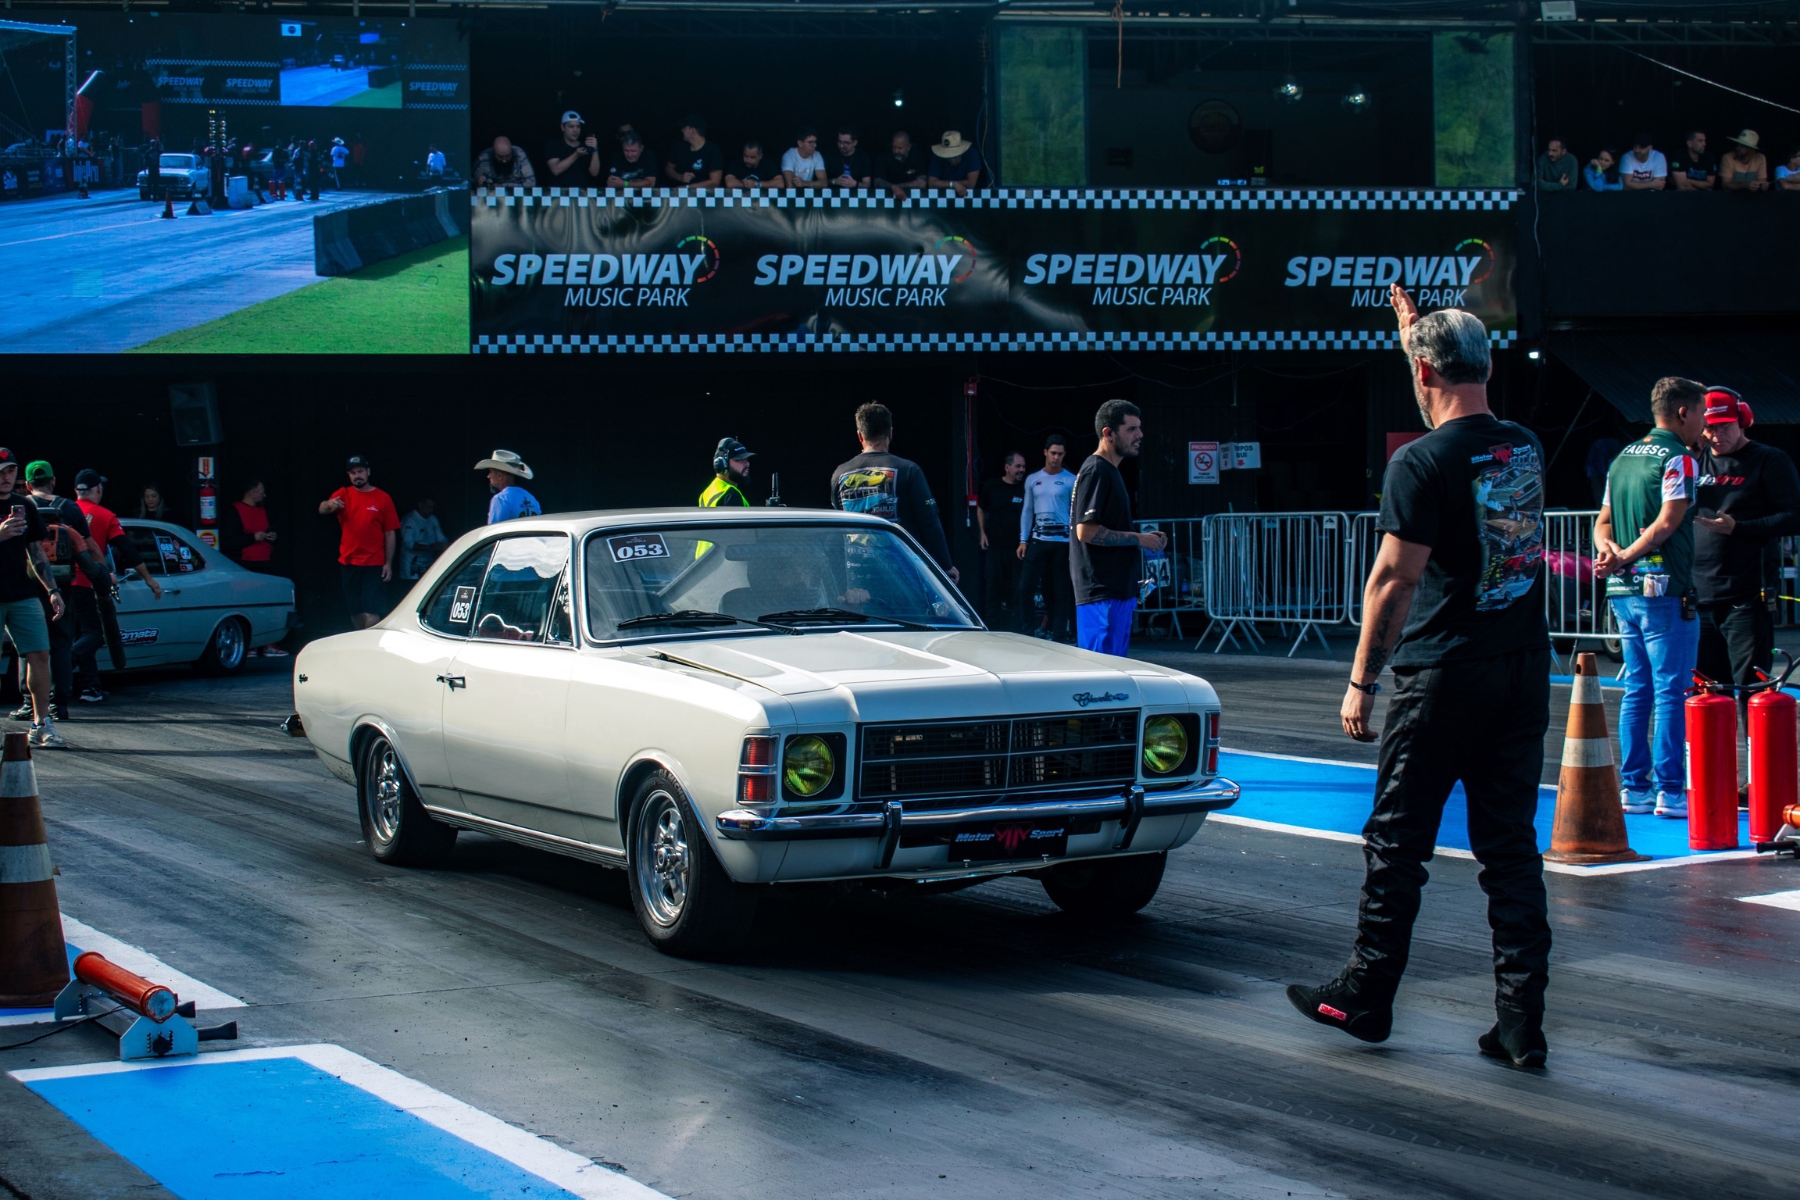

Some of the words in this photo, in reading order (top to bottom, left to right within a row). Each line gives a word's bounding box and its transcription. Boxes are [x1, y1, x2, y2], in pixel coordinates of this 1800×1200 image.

[158, 77, 204, 86] SPEEDWAY
[226, 78, 273, 88] SPEEDWAY
[409, 81, 458, 92] SPEEDWAY
[491, 254, 706, 285] SPEEDWAY
[754, 254, 963, 286] SPEEDWAY
[1023, 254, 1227, 285] SPEEDWAY
[1284, 256, 1482, 287] SPEEDWAY
[564, 288, 633, 307] MUSIC
[637, 288, 691, 307] PARK
[825, 288, 892, 307] MUSIC
[895, 288, 948, 307] PARK
[1092, 287, 1158, 306] MUSIC
[1161, 287, 1213, 306] PARK
[1418, 289, 1468, 307] PARK
[1512, 444, 1531, 455] Sport
[1621, 444, 1670, 457] FAUESC
[617, 543, 664, 559] 053
[452, 601, 470, 619] 053
[955, 833, 995, 842] Motor
[1029, 827, 1065, 839] Sport
